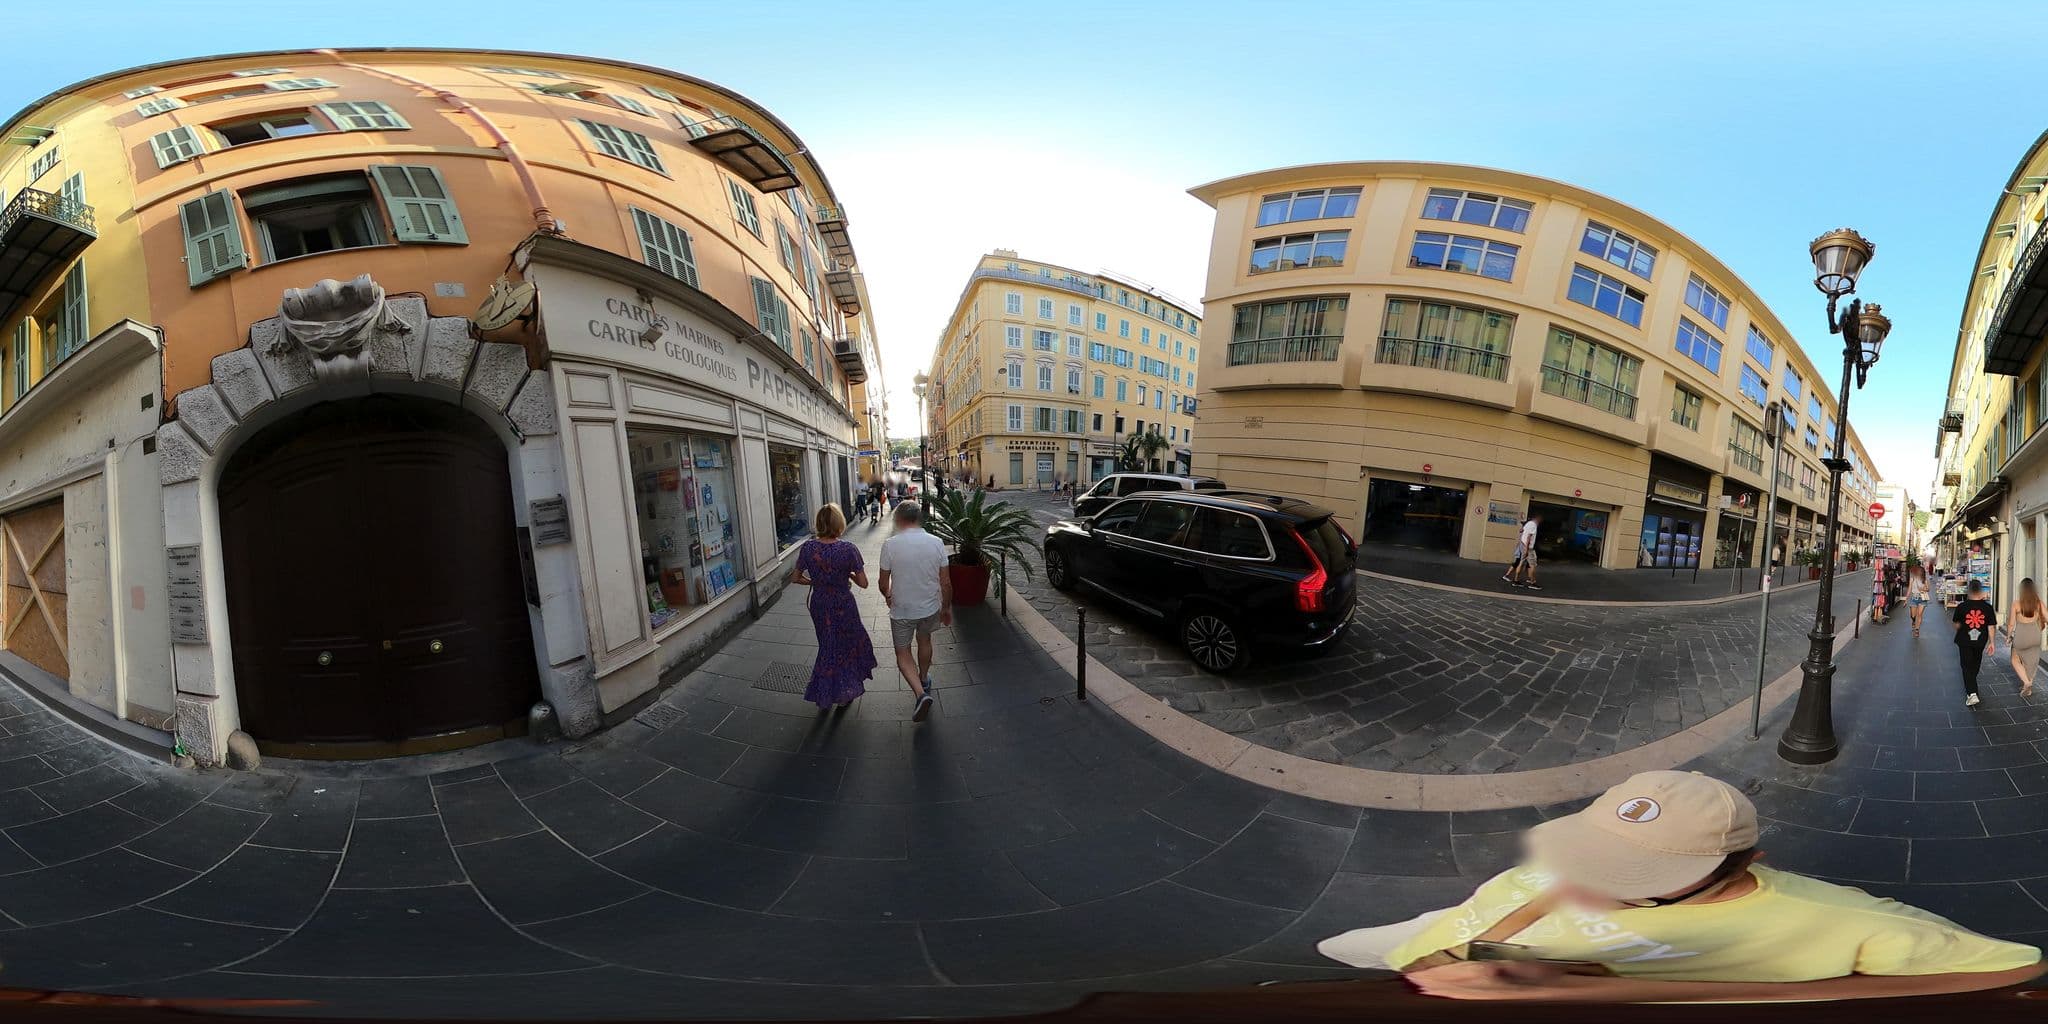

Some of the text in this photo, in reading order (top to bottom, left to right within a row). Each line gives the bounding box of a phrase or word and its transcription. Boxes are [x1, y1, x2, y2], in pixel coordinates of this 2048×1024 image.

[675, 321, 725, 356] MARINES
[664, 341, 738, 381] GEOLOGIQUES
[1186, 397, 1195, 410] P
